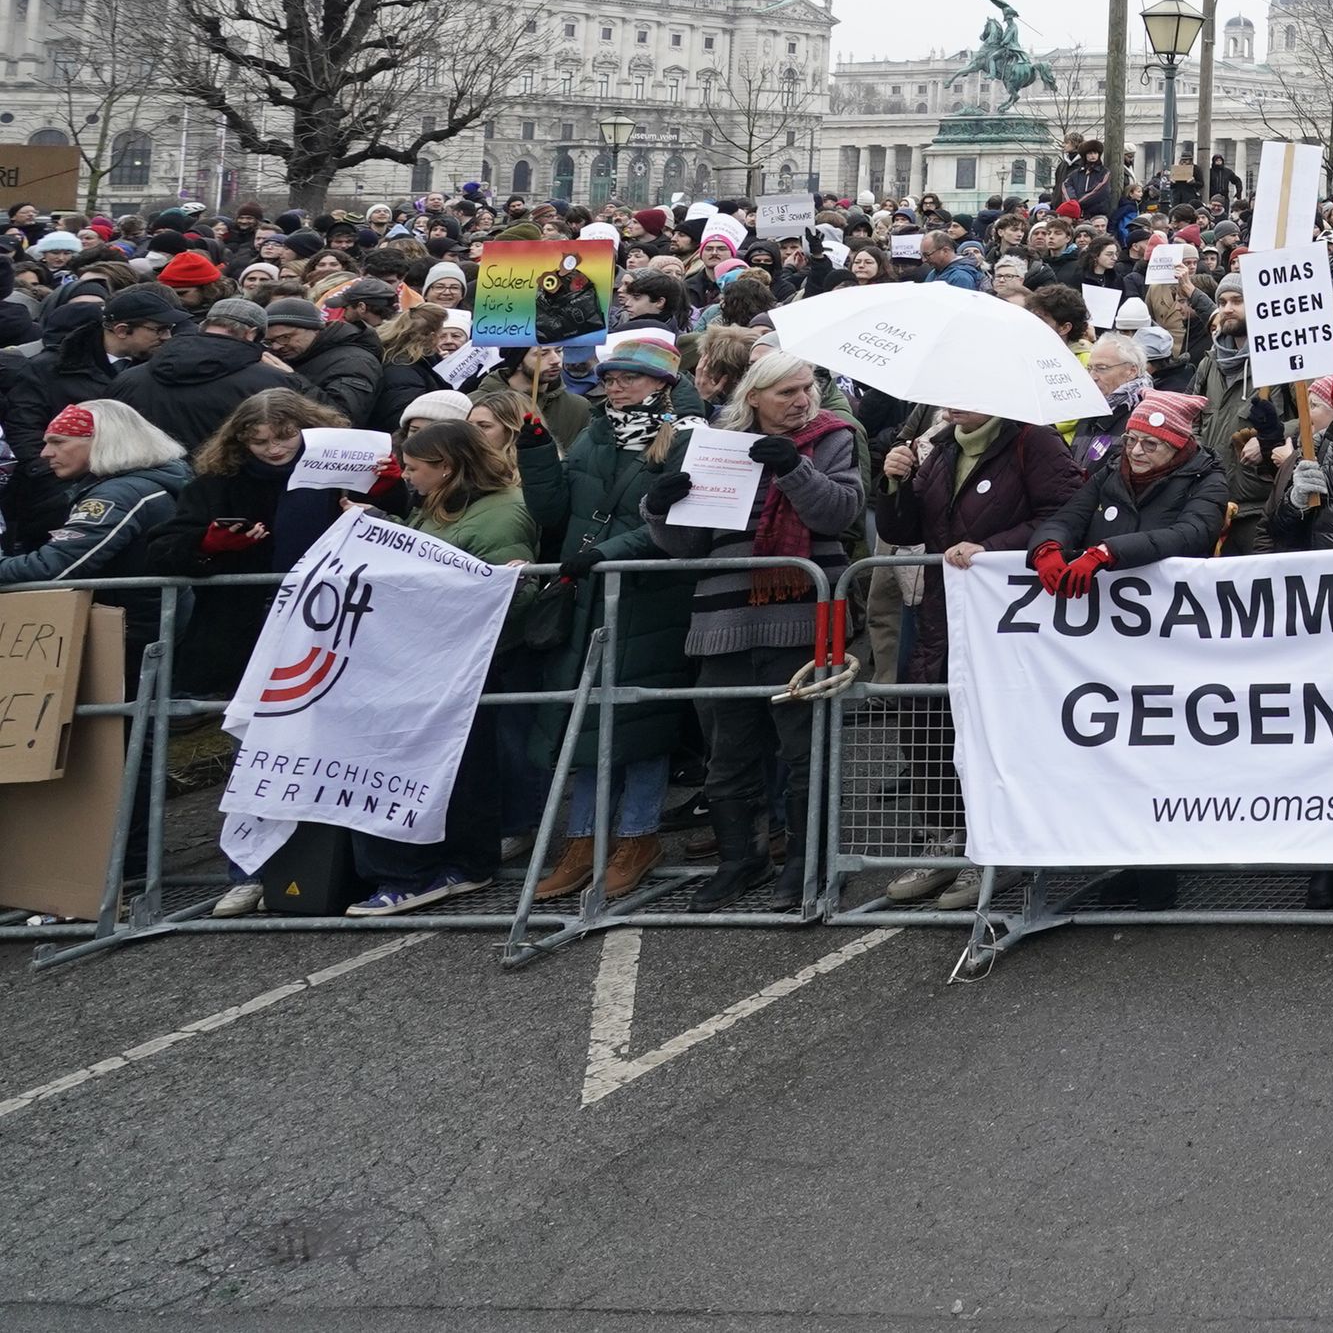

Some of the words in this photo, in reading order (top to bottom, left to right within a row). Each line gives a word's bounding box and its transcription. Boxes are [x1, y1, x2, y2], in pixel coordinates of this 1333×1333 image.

[762, 206, 773, 216] ES
[777, 204, 789, 213] IST
[482, 265, 535, 290] Sackerl
[1258, 262, 1314, 286] OMAS
[1256, 293, 1324, 319] GEGEN
[476, 316, 532, 336] Gackerl
[874, 321, 917, 342] OMAS
[858, 331, 904, 354] GEGEN
[1254, 324, 1333, 353] RECHTS
[838, 342, 891, 367] RECHTS
[1045, 372, 1072, 385] GEGEN
[1051, 388, 1082, 401] RECHTS
[321, 449, 339, 459] NIE
[340, 450, 375, 461] WIEDER
[357, 524, 417, 553] JEWISH
